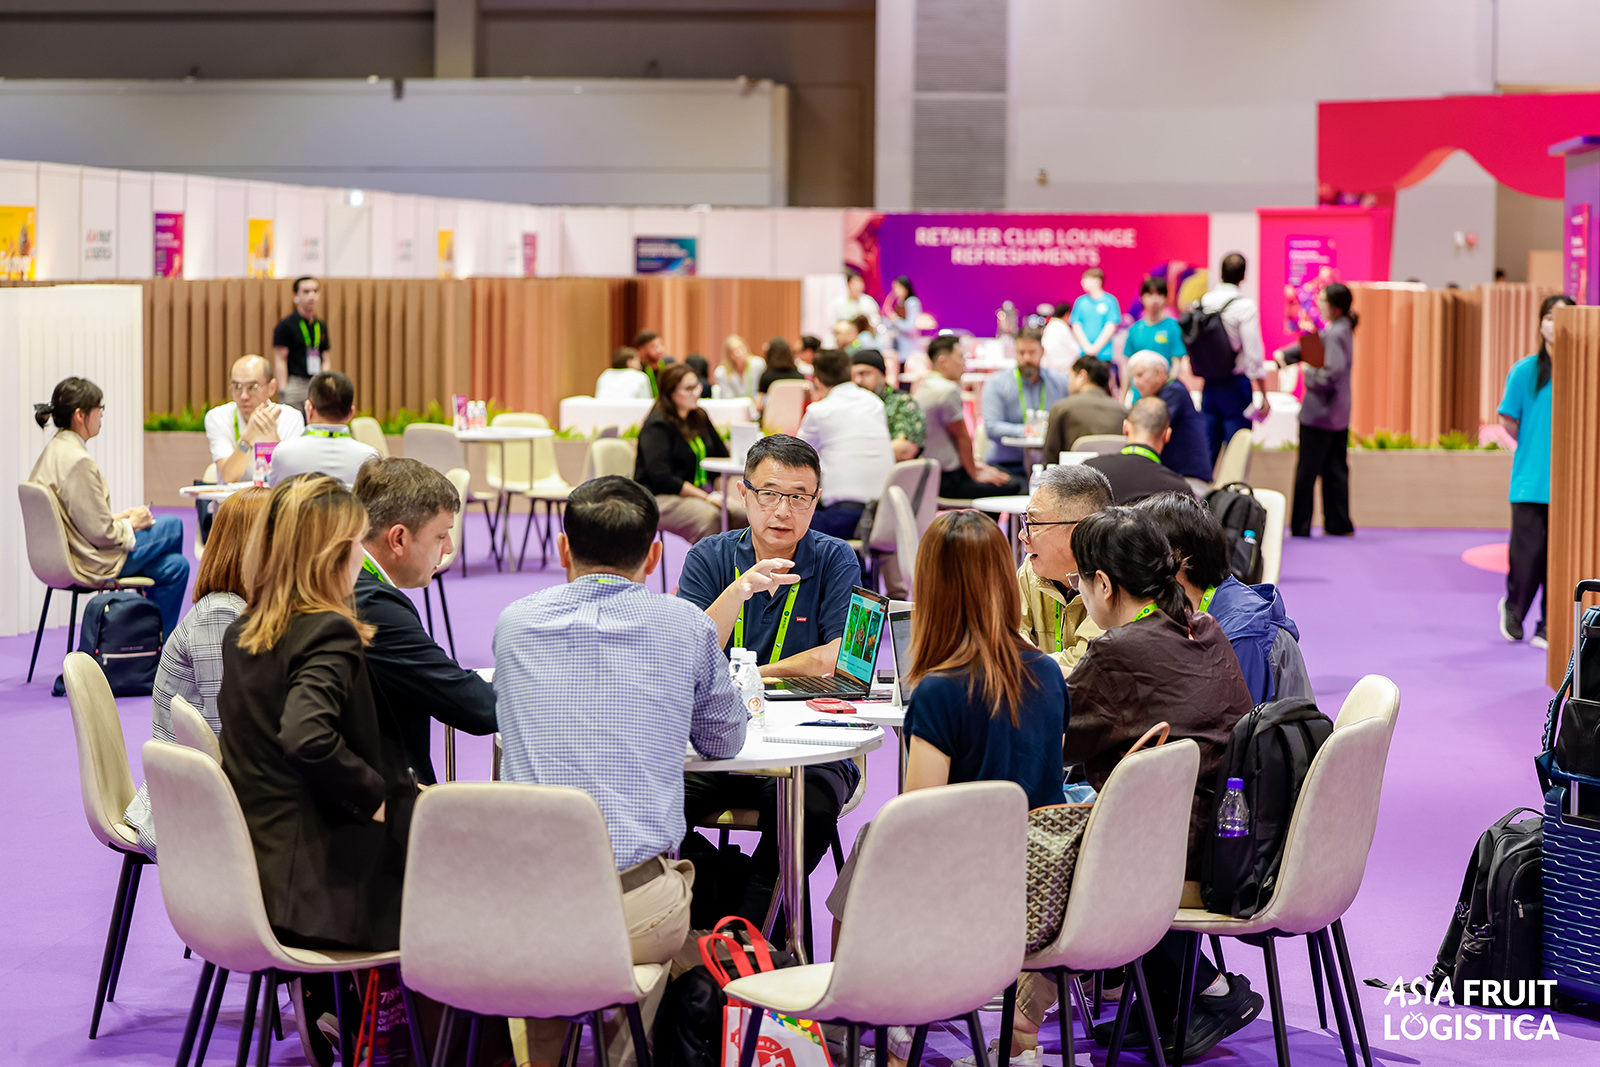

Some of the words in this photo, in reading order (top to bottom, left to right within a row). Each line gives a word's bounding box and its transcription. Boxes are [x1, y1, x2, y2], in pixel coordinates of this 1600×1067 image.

[915, 227, 1002, 246] RETAILER
[1004, 227, 1055, 247] CLUB
[1056, 228, 1137, 248] LOUNGE
[951, 246, 1100, 266] REFRESHMENTS
